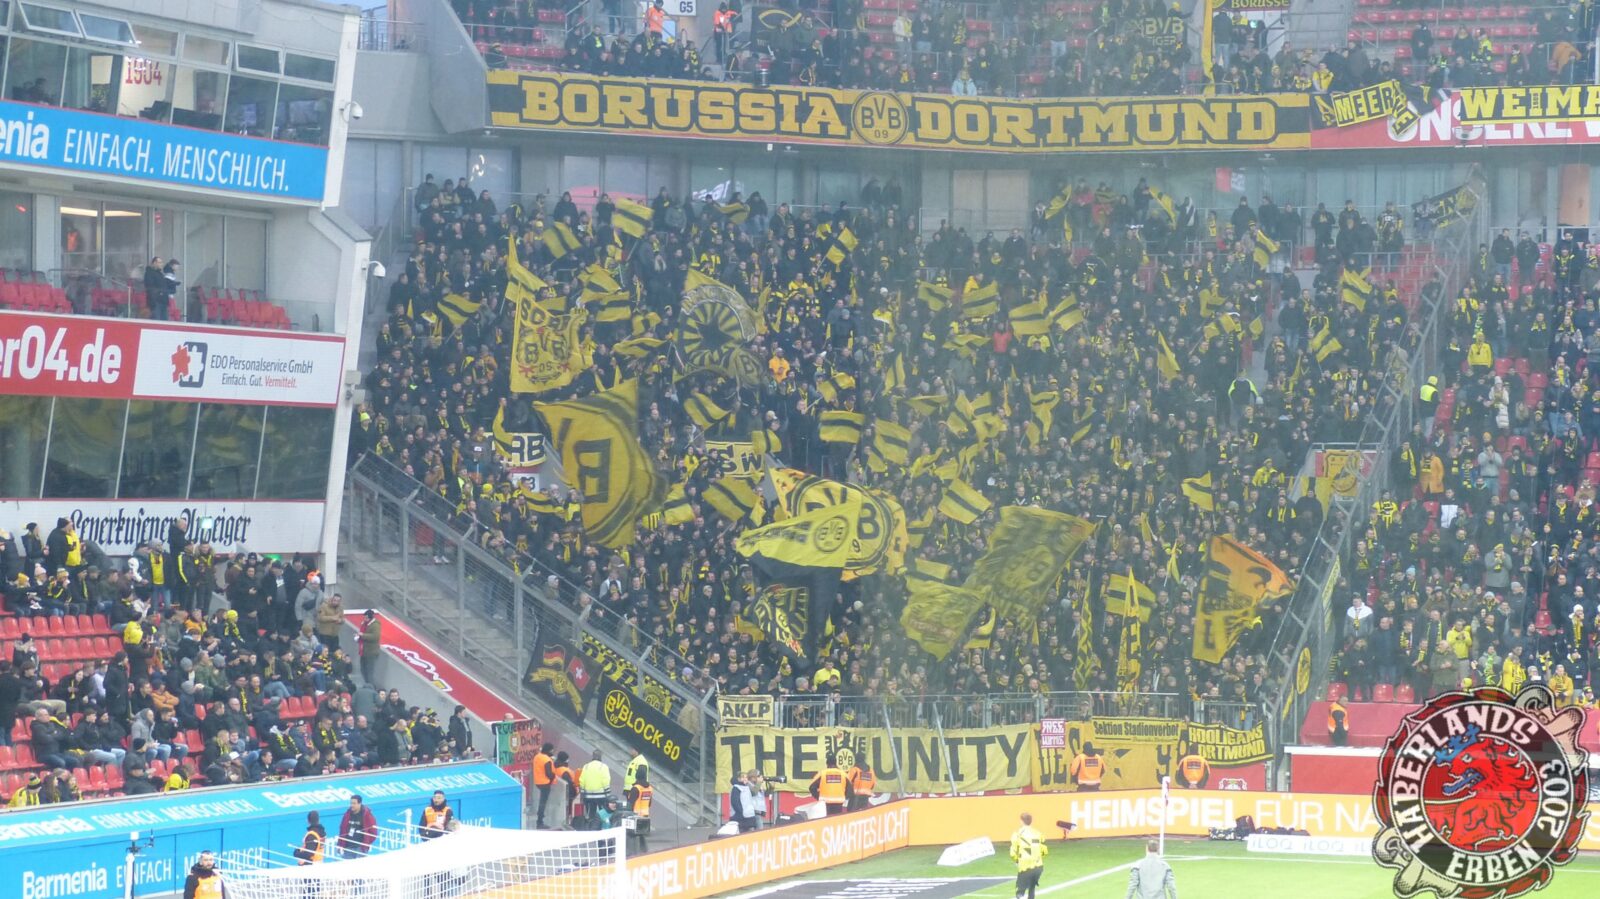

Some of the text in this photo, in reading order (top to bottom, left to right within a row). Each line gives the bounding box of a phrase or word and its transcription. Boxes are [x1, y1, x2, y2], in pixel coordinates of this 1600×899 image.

[680, 1, 693, 13] G5
[1145, 17, 1184, 34] BVB
[125, 56, 162, 86] 1904
[522, 80, 848, 136] BORUSSIA
[915, 101, 1276, 145] DORTMUND
[861, 97, 901, 130] BVB
[874, 129, 889, 139] 09
[64, 128, 154, 174] EINFACH.
[163, 143, 289, 191] MENSCHLICH.
[0, 325, 122, 384] r04.de
[211, 355, 313, 374] EDO Personalservice GmbH
[222, 373, 248, 386] Einfach.
[249, 374, 263, 387] Gut.
[722, 702, 770, 718] AKLP
[1189, 723, 1264, 746] HOOLIGANS
[663, 739, 681, 761] 80
[721, 732, 1028, 782] THE UNITY
[1190, 740, 1266, 761] ORTMUND
[262, 785, 355, 808] Barmenia
[1070, 798, 1237, 830] HEIMSPIEL
[1255, 794, 1324, 832] FÜR
[685, 846, 714, 891] FÜR
[716, 829, 818, 884] NACHHALTIGES,
[820, 814, 878, 860] SMARTES
[876, 807, 909, 847] LICHT
[22, 862, 108, 899] Barmenia
